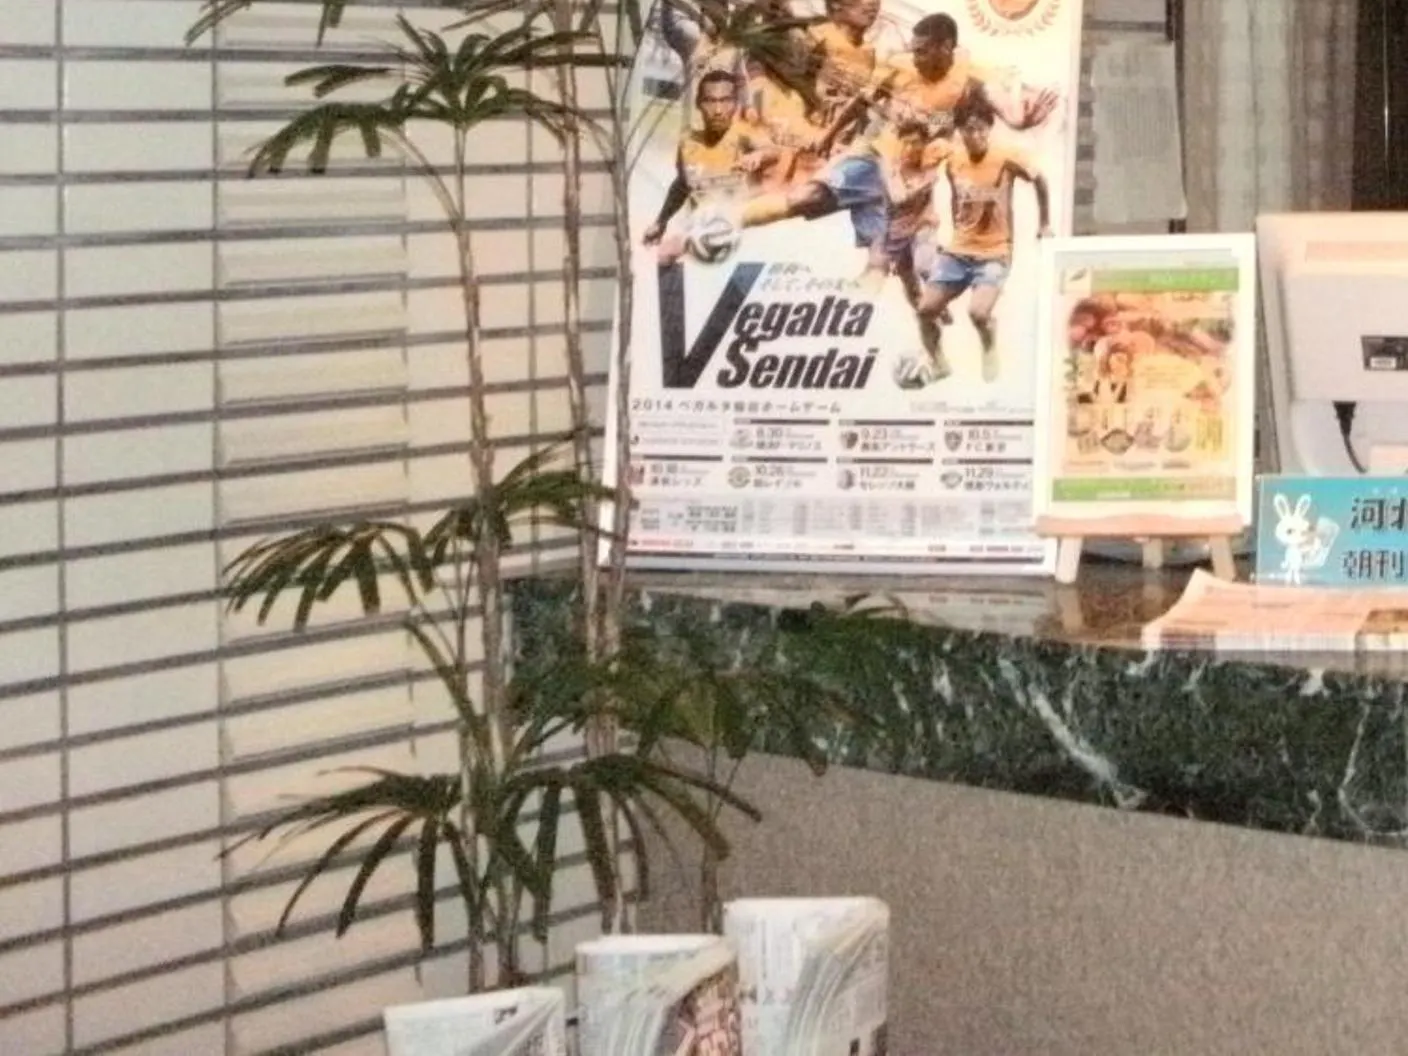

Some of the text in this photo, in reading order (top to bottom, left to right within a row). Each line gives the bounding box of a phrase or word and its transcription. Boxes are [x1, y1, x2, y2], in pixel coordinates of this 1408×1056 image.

[657, 262, 875, 389] Vegalta
[716, 336, 879, 389] Sendai
[1343, 550, 1405, 578] 朝刊
